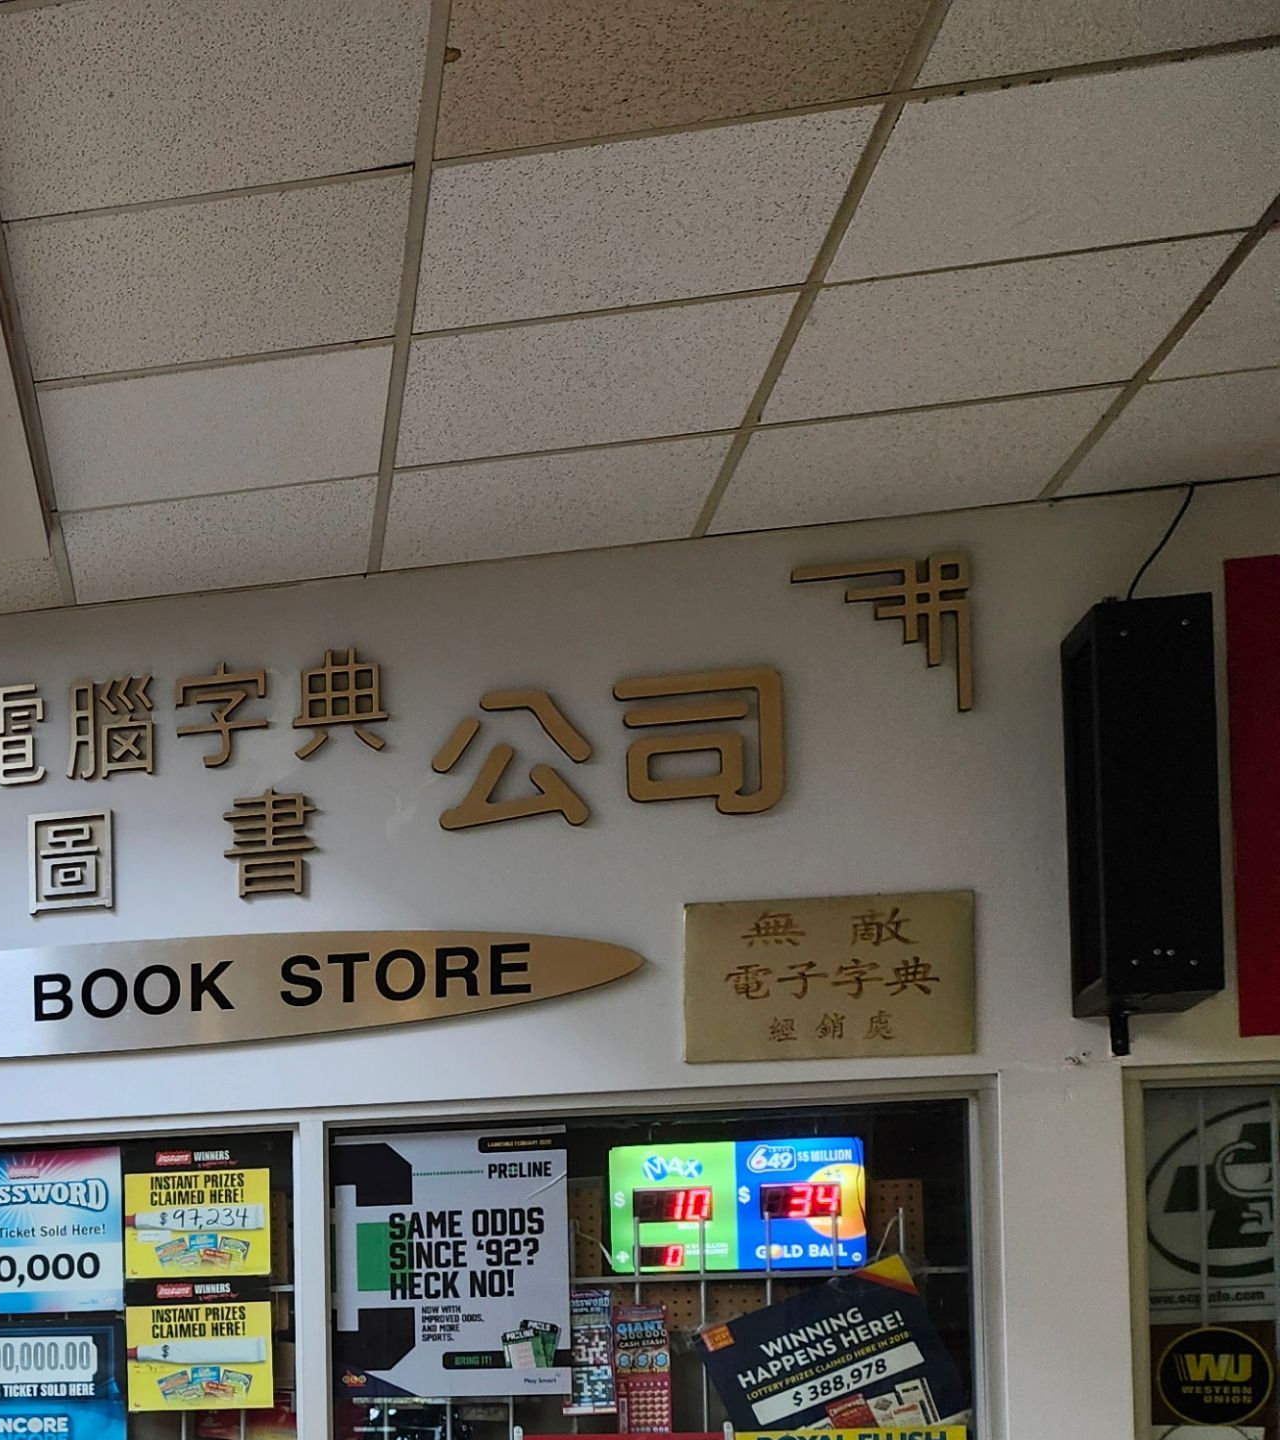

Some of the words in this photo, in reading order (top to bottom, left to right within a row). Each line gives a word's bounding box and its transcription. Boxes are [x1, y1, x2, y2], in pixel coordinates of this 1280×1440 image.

[431, 665, 787, 832] 公司
[34, 959, 237, 1023] BOOK
[279, 942, 534, 1003] STORE
[723, 957, 943, 1001] 電子字典
[750, 1147, 793, 1170] 649
[797, 1150, 809, 1162] $5
[811, 1148, 853, 1162] MILLION
[644, 1156, 702, 1182] MAX
[150, 1175, 200, 1191] INSTANT
[204, 1173, 245, 1188] PRIZES
[150, 1190, 205, 1206] CLAIMED
[209, 1188, 245, 1204] HERE!
[614, 1192, 626, 1208] $
[672, 1189, 711, 1220] 10
[738, 1185, 751, 1204] $
[173, 1207, 249, 1230] 97,234
[389, 1211, 463, 1240] SAME
[471, 1207, 545, 1238] ODDS
[40, 1225, 68, 1238] Sold
[71, 1223, 107, 1237] Here!
[389, 1240, 468, 1270] SINCE
[809, 1243, 848, 1258] BALL
[390, 1270, 460, 1300] HECK
[469, 1269, 515, 1299] NO!
[421, 1306, 440, 1314] NOW
[441, 1305, 462, 1314] WITH
[421, 1314, 460, 1324] IMPROVED
[461, 1314, 485, 1323] ODDS.
[421, 1324, 439, 1333] AND
[439, 1324, 461, 1333] MORE
[421, 1333, 456, 1342] SPORTS.
[737, 1338, 838, 1391] HAPPENS
[840, 1310, 907, 1351] HERE!
[747, 1381, 785, 1401] LOTTERY
[785, 1369, 814, 1386] PRIZES
[815, 1353, 853, 1376] CLAIMED
[853, 1345, 877, 1362] HERE
[877, 1341, 888, 1352] IN
[1184, 1353, 1253, 1382] WU
[2, 1384, 38, 1398] TICKET
[40, 1384, 67, 1397] SOLD
[69, 1382, 95, 1397] HERE
[1180, 1385, 1253, 1394] WESTERN
[1203, 1395, 1253, 1404] UNION
